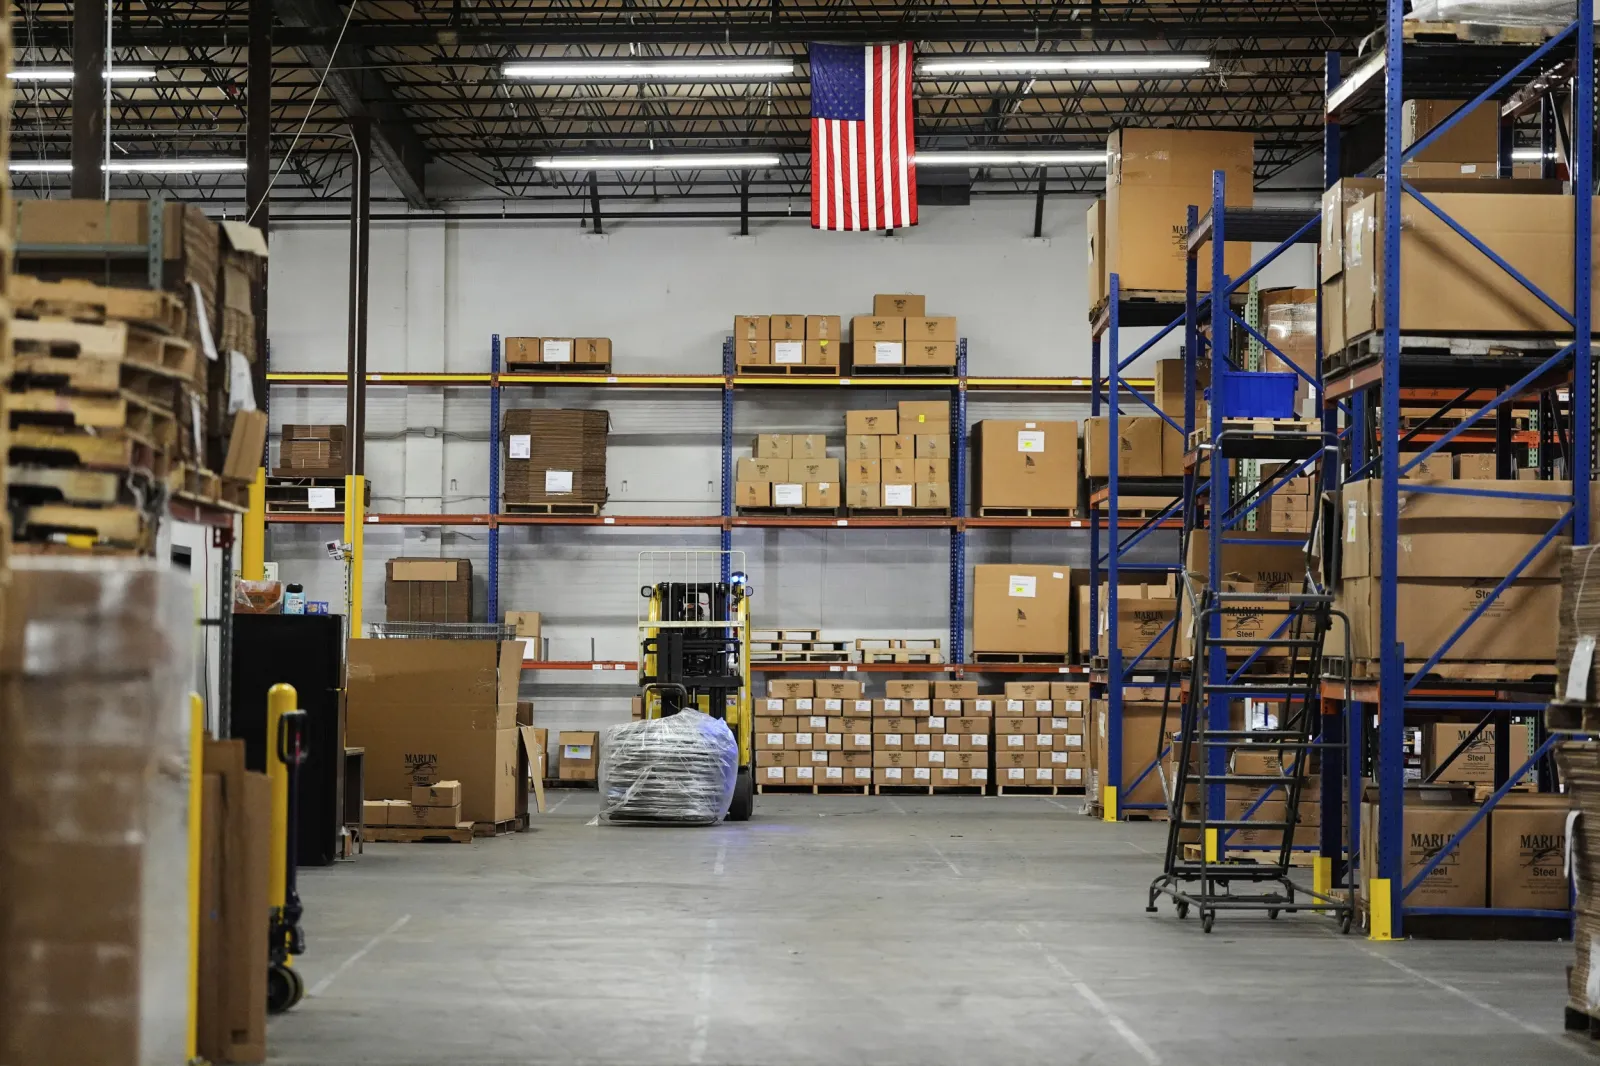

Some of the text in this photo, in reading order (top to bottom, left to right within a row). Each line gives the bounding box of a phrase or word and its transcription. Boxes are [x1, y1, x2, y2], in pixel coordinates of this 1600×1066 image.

[1257, 571, 1293, 581] MARLIN
[1133, 610, 1163, 620] MARLIN
[1236, 630, 1255, 638] Steel
[404, 753, 438, 764] MARLIN
[1467, 754, 1486, 762] Steel
[1411, 833, 1460, 848] MARLI
[1532, 867, 1557, 877] Steel
